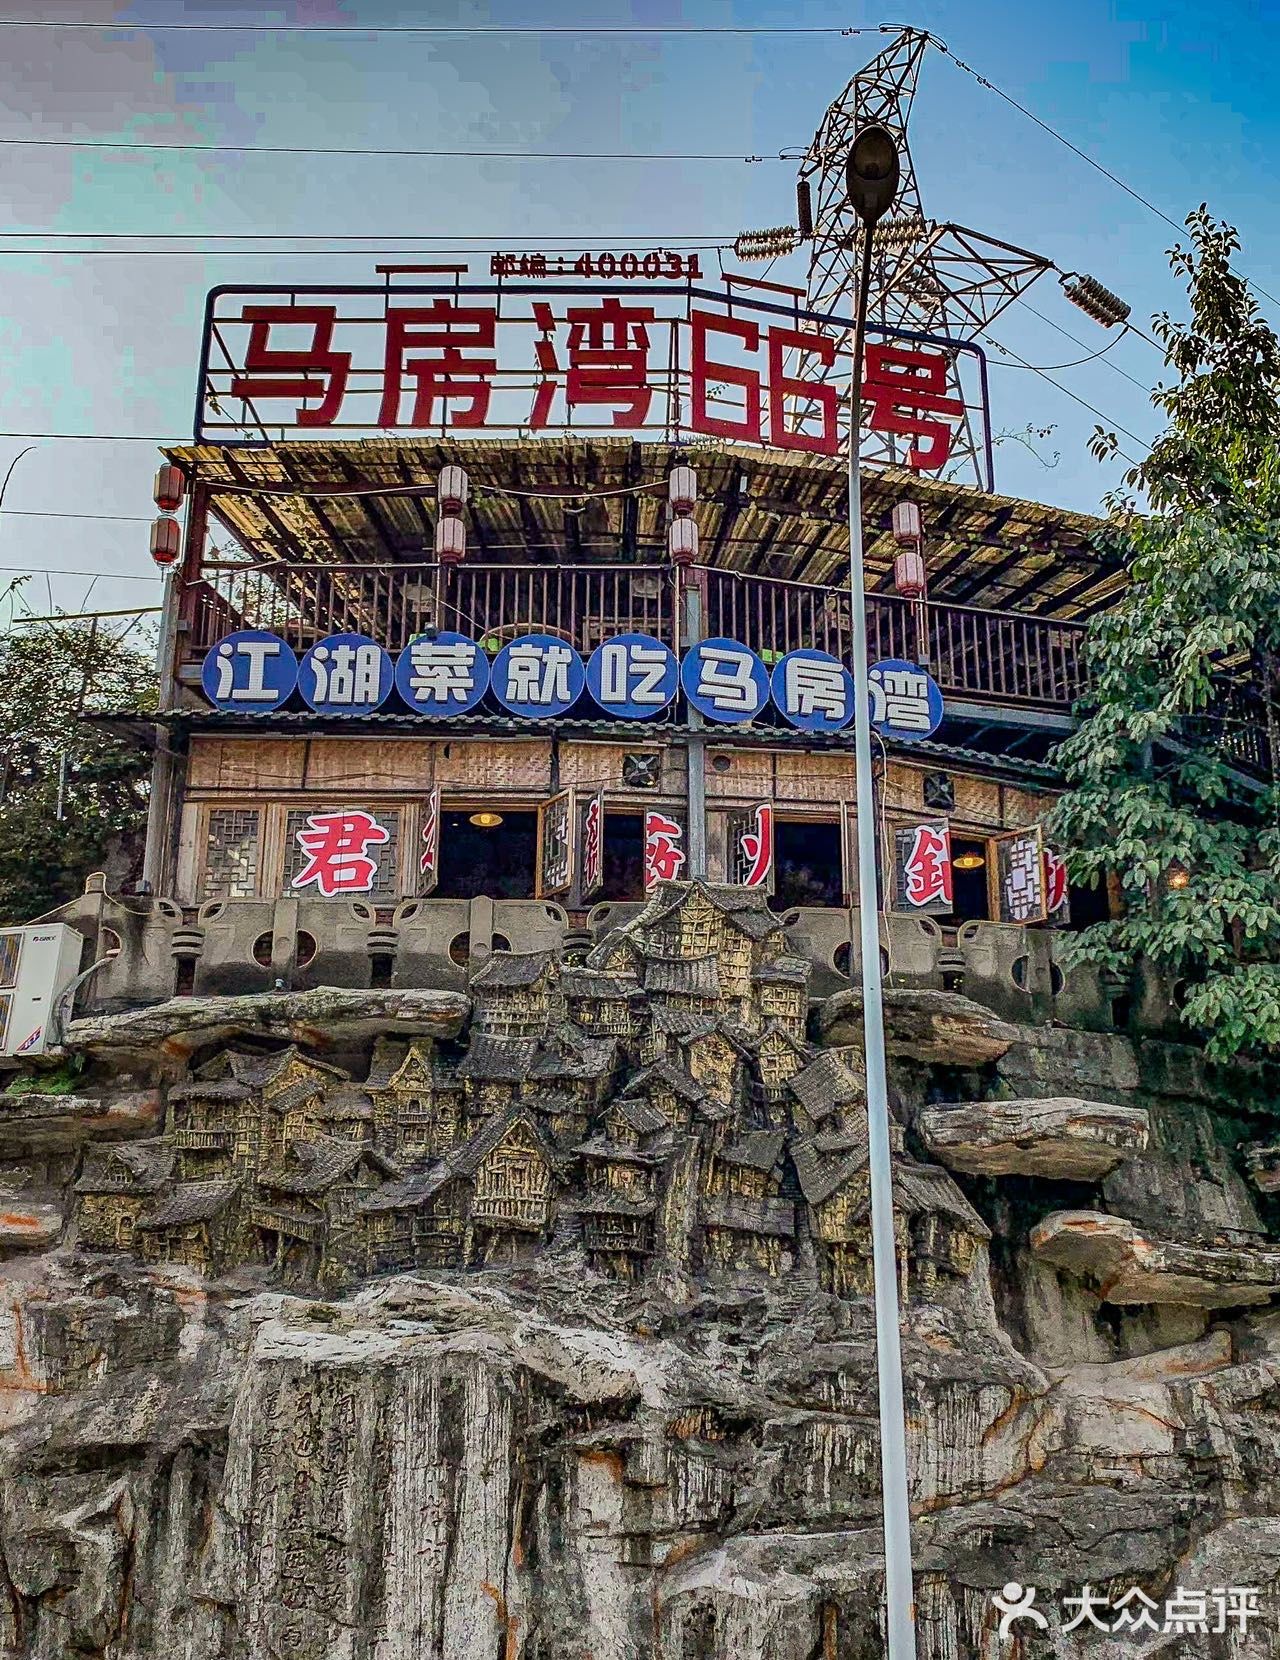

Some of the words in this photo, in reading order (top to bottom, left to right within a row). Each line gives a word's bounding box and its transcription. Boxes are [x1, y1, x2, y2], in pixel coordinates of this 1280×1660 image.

[231, 296, 966, 472] 马房湾66号
[215, 641, 932, 732] 江湖菜就吃马房湾
[291, 810, 390, 897] 君
